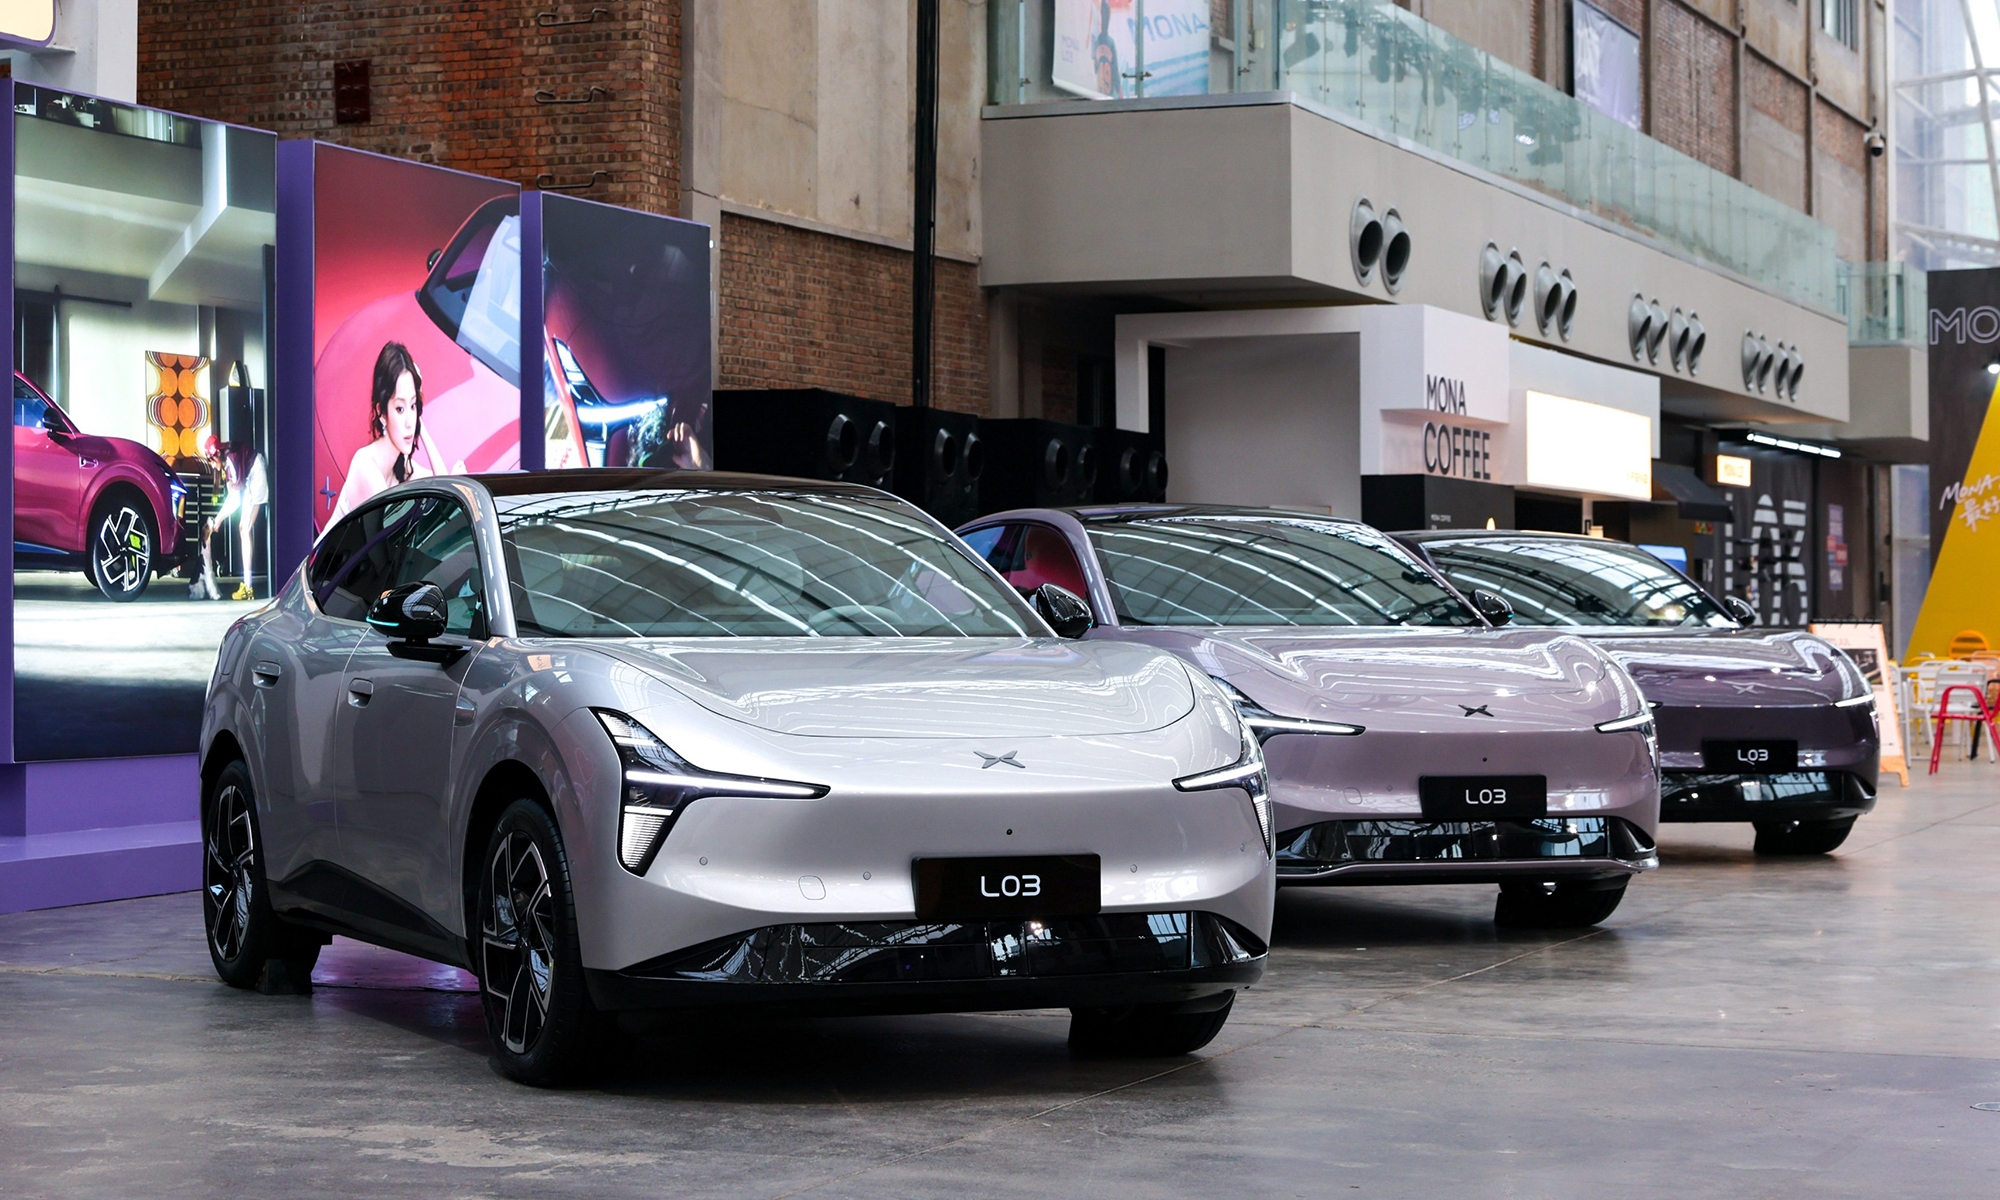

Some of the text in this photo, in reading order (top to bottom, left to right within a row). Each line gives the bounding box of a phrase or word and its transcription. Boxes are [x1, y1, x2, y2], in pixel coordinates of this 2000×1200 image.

[1127, 12, 1210, 44] MONA
[1426, 374, 1467, 416] MONA
[1424, 421, 1491, 480] COFFEE
[1737, 749, 1769, 761] L03
[1465, 789, 1506, 804] L03
[980, 874, 1041, 898] L03
